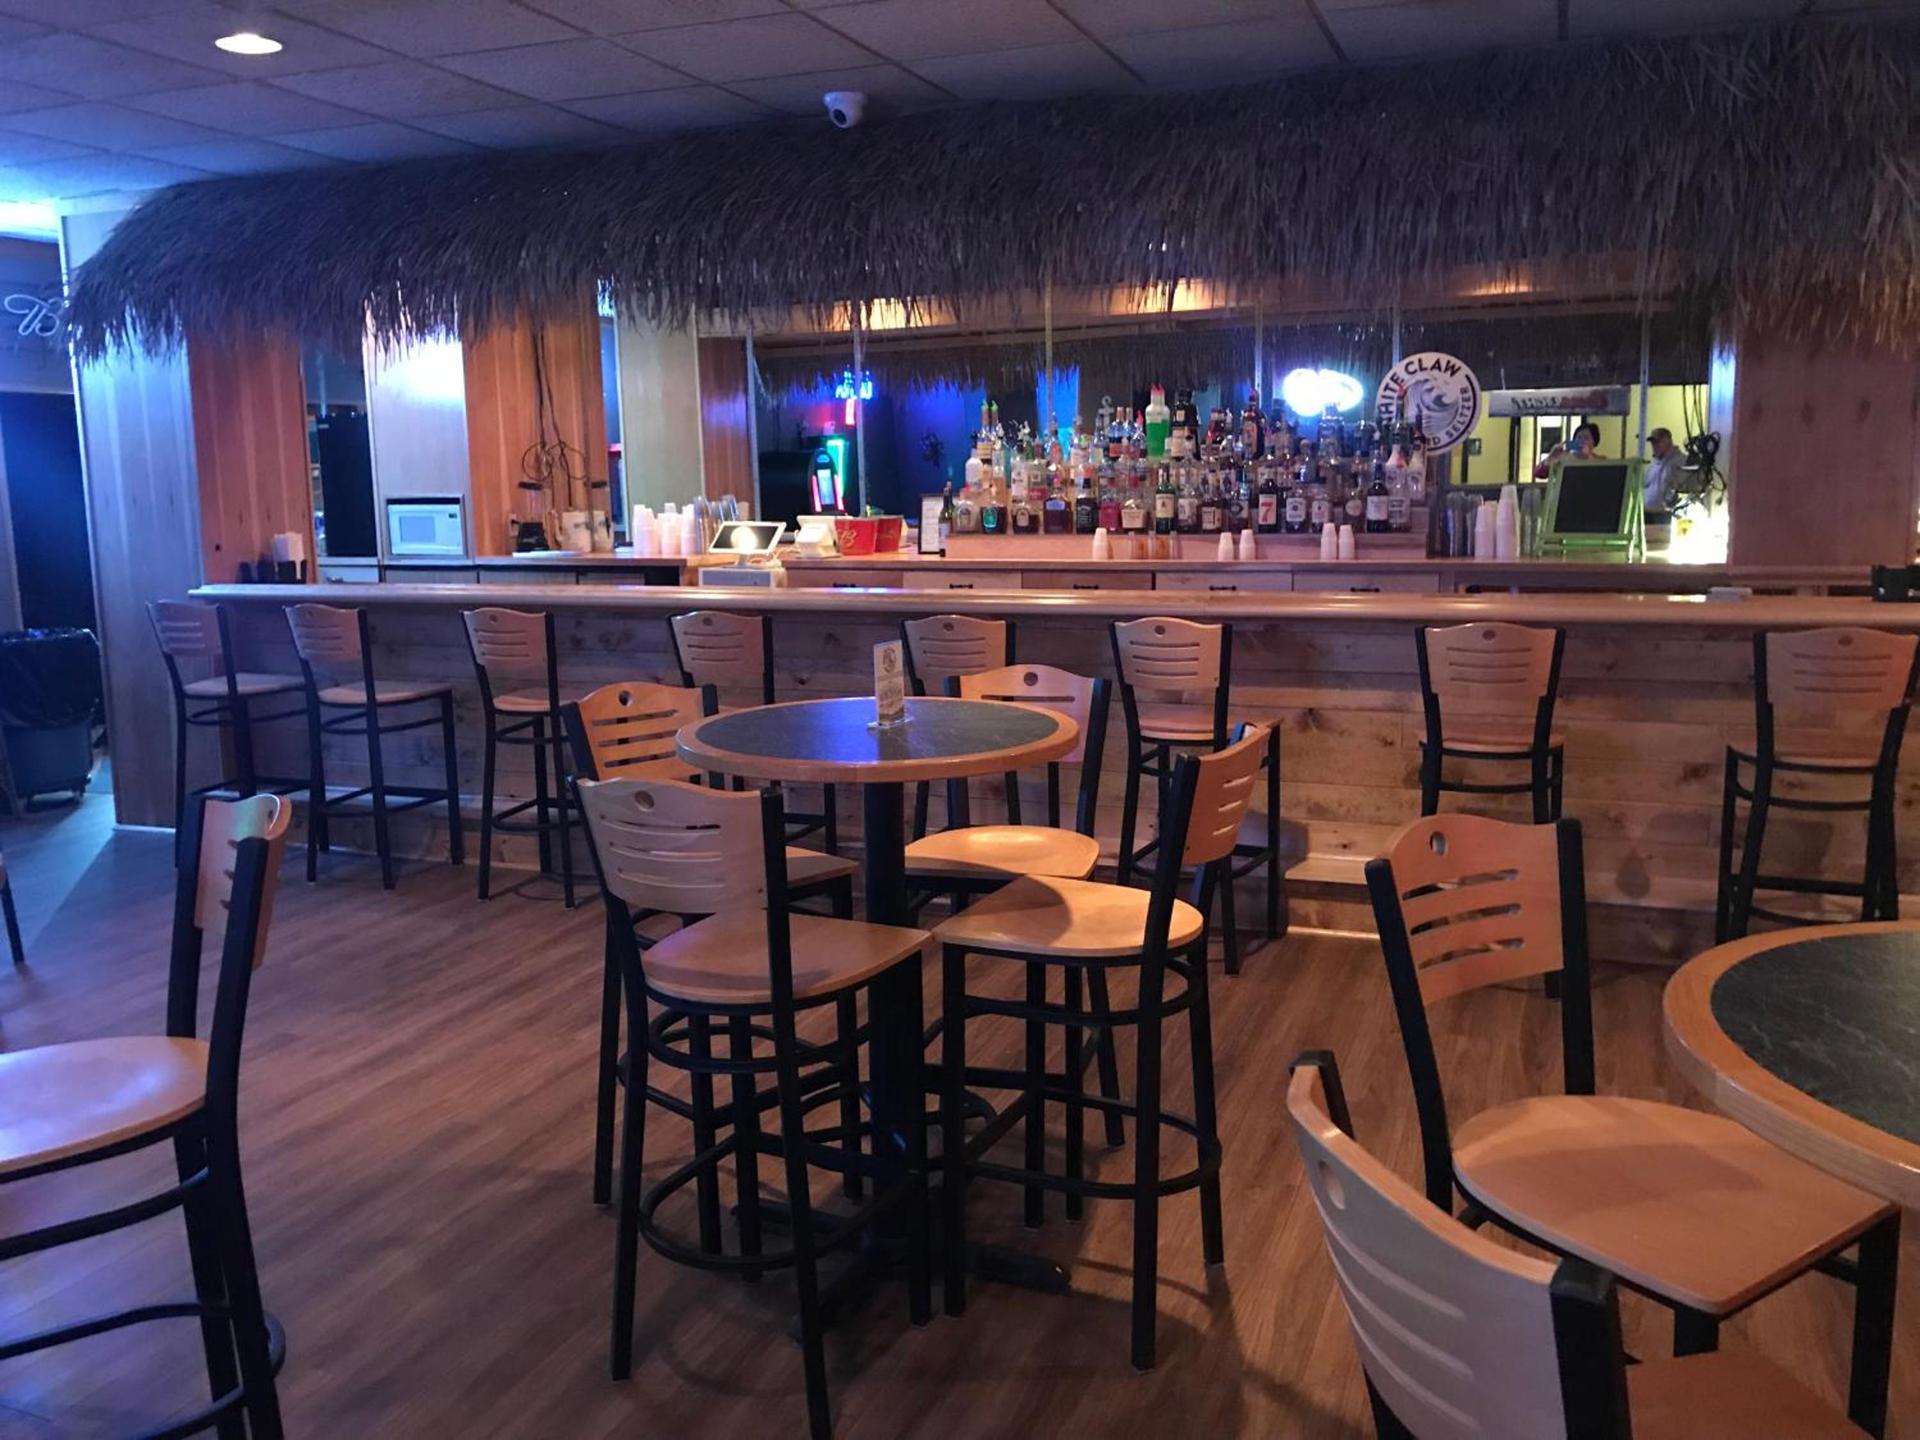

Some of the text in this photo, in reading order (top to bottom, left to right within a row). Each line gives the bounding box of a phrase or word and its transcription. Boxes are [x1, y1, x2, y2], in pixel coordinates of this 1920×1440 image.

[1380, 358, 1461, 424] HITE CLAW
[1445, 386, 1471, 438] SELTZER
[1261, 501, 1273, 522] 7
